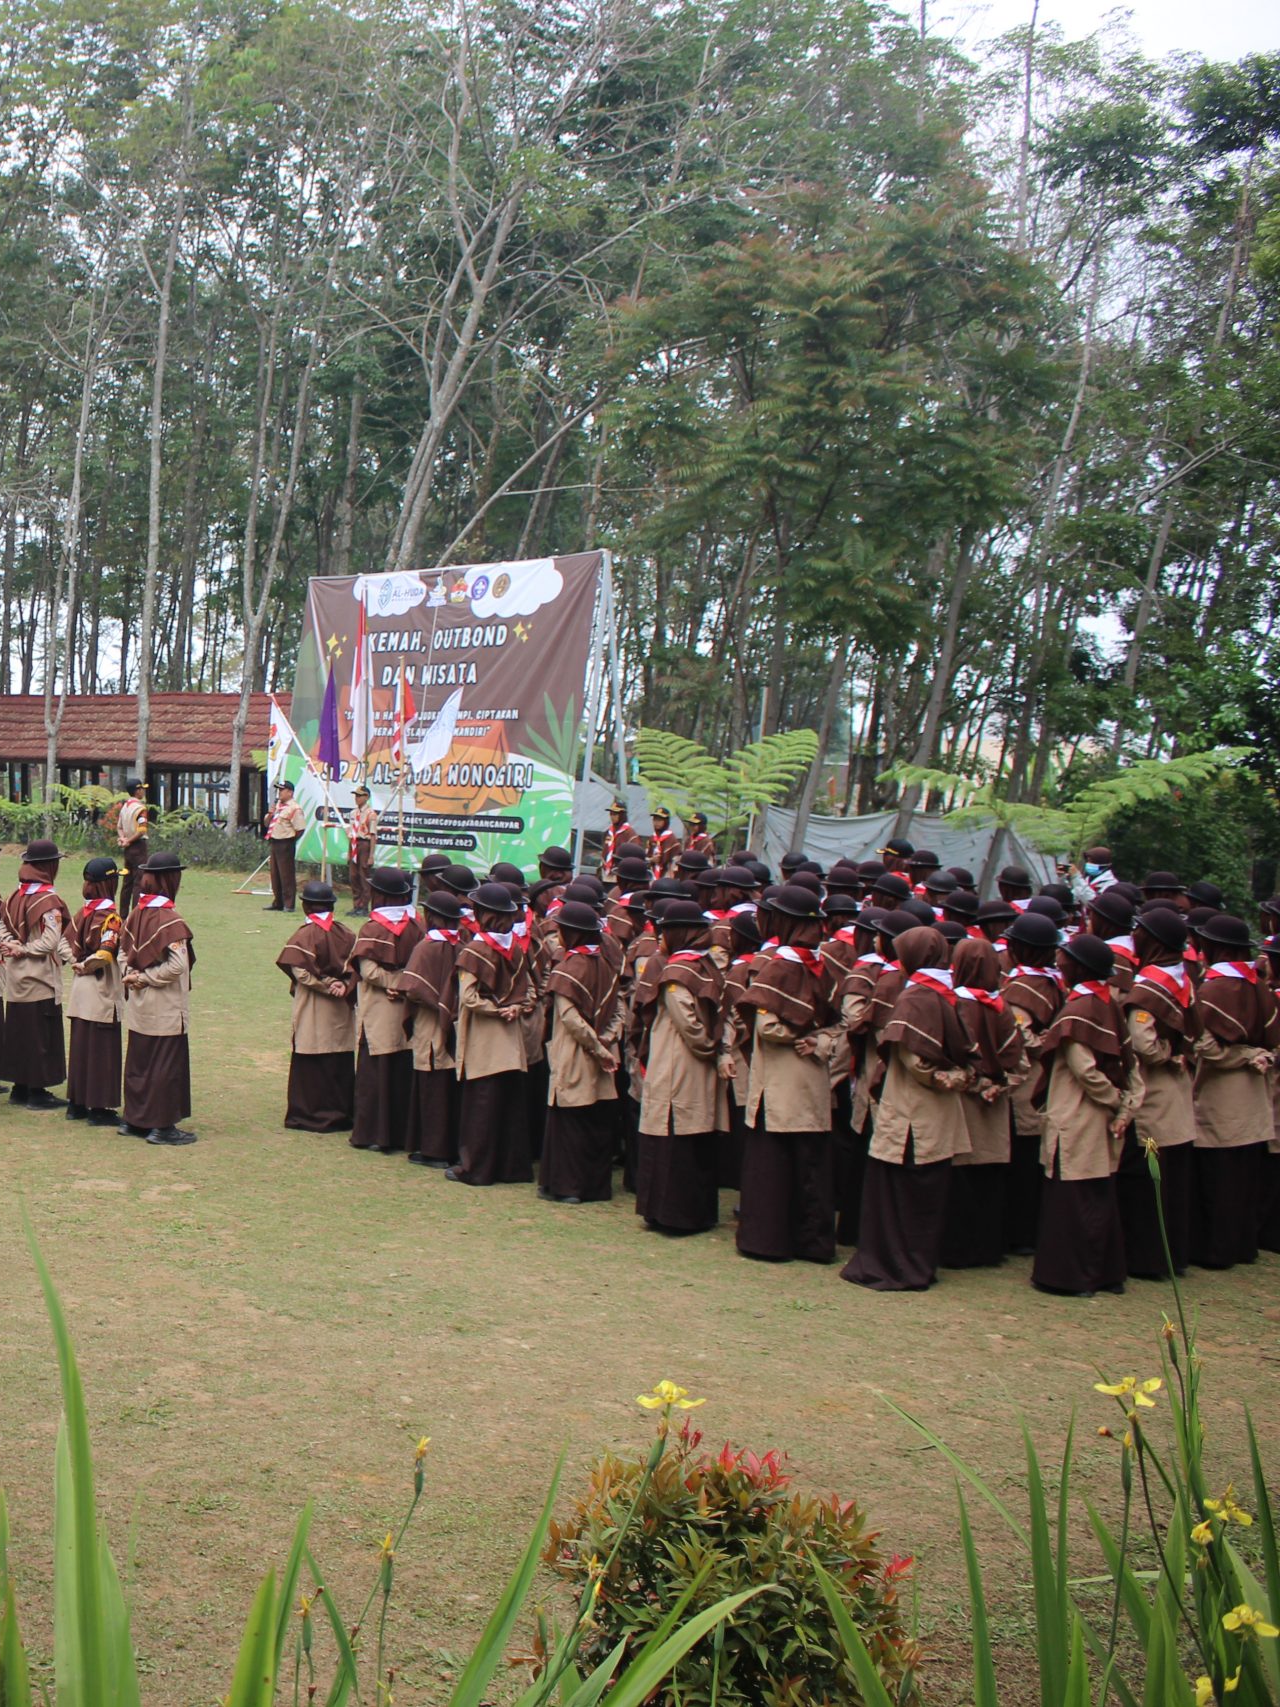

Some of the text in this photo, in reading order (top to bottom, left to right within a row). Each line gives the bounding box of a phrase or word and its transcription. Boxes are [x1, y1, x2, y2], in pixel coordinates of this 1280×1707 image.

[433, 624, 508, 650] OUTBOND
[421, 662, 477, 686] WISATA
[447, 763, 534, 787] WONOGIRI
